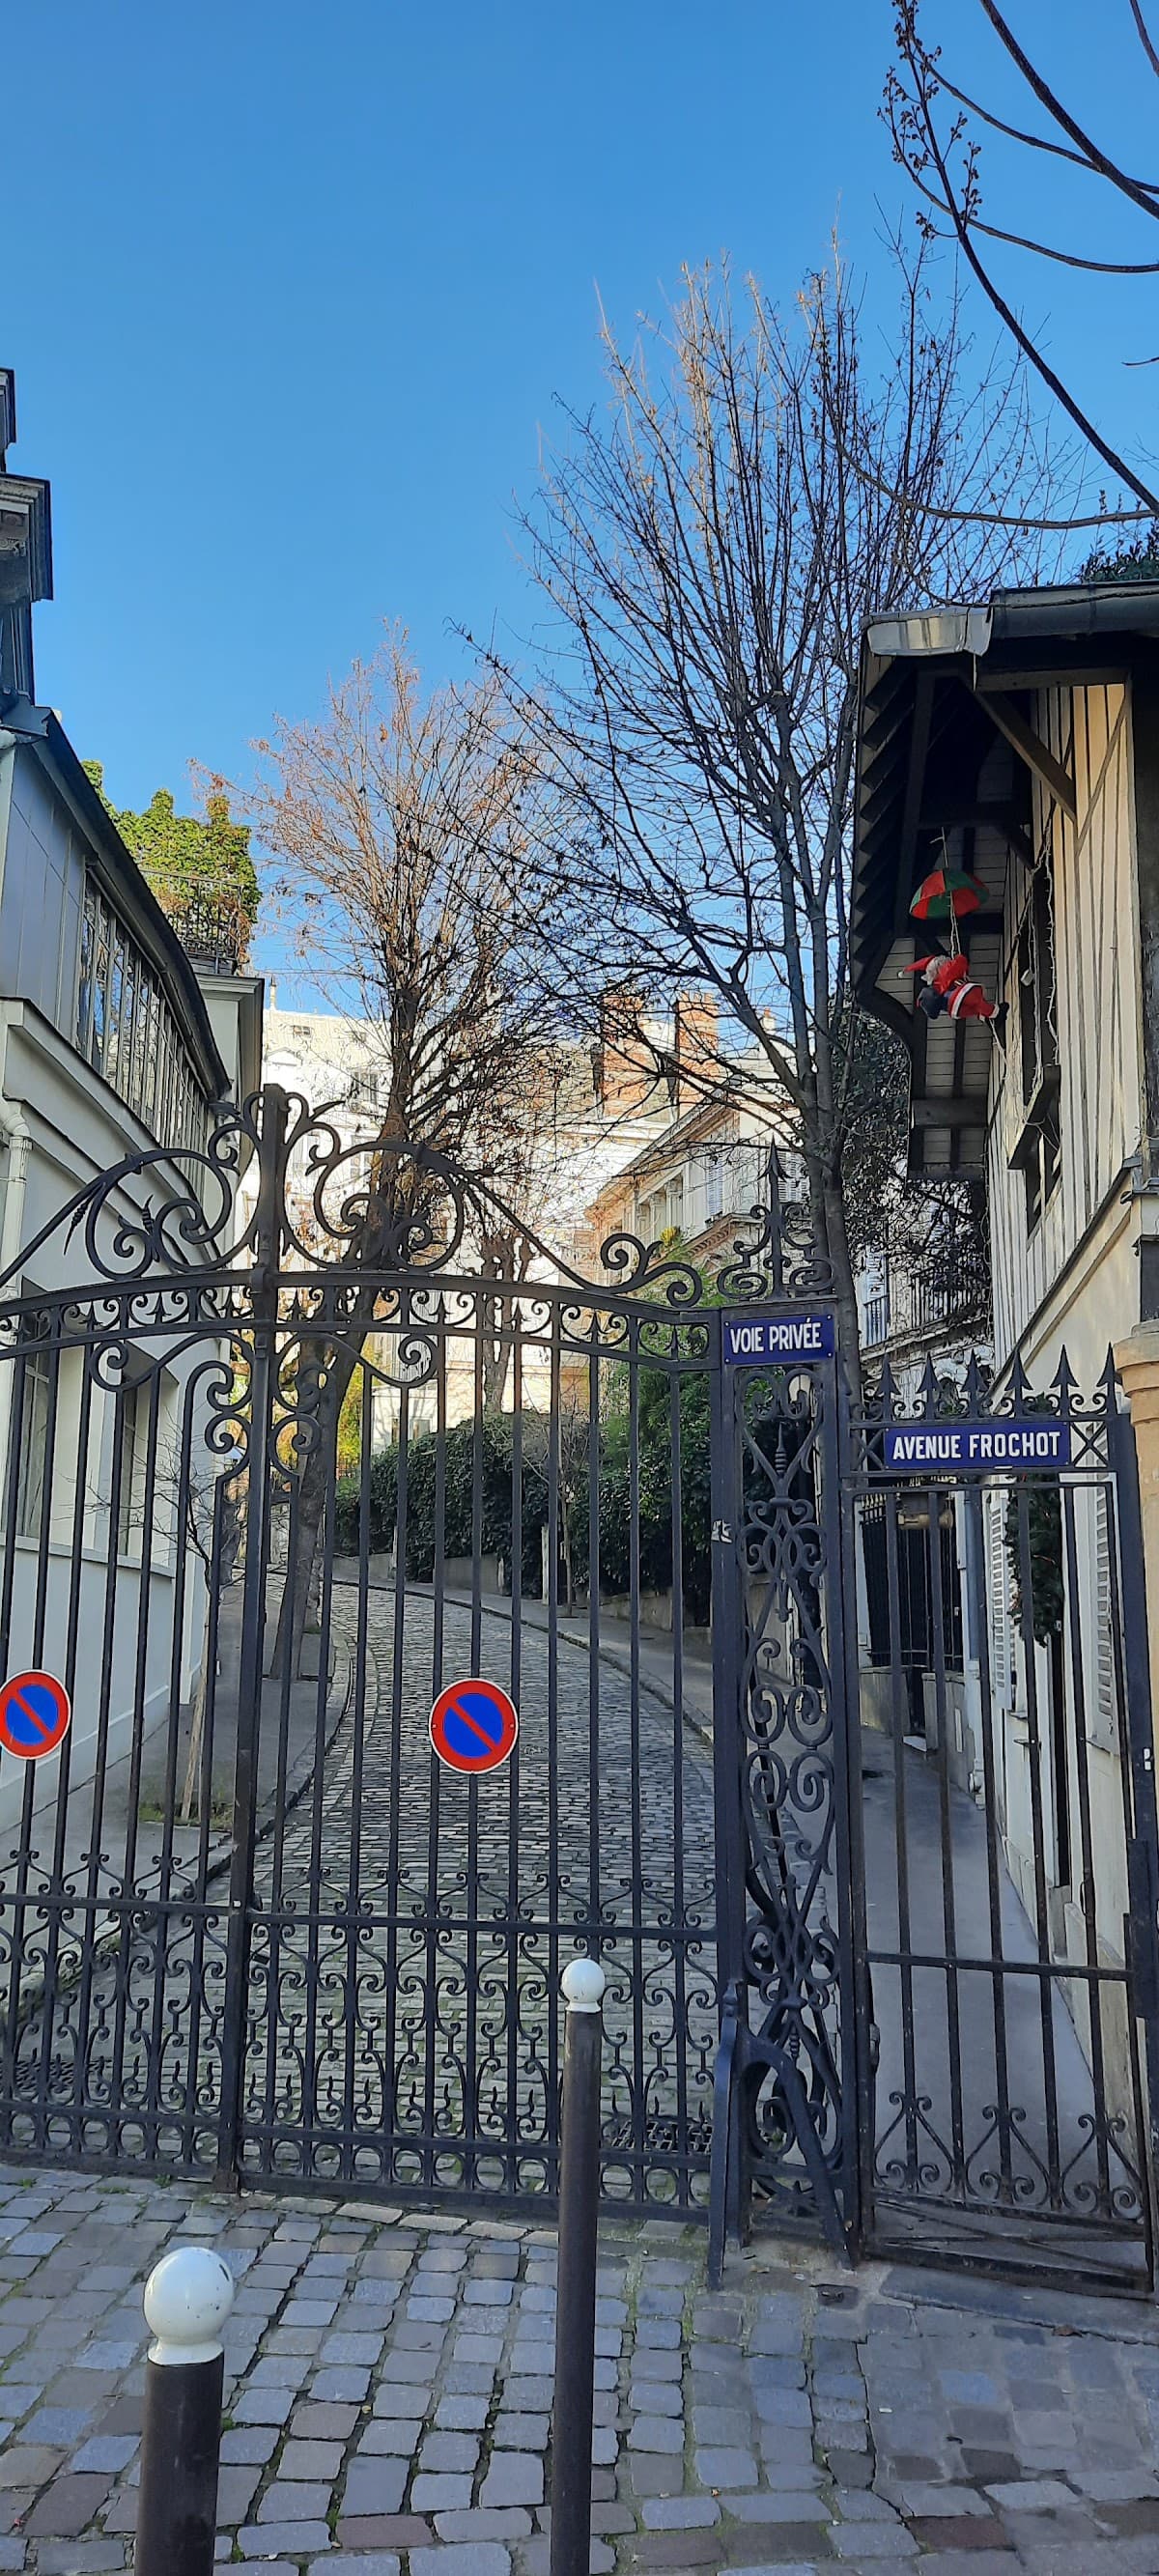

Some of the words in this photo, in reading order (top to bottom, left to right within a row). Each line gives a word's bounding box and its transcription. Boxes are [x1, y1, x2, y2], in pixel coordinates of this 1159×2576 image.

[730, 1326, 764, 1353] VOIE
[769, 1316, 822, 1350] PRIVÉE
[892, 1434, 962, 1459] AVENUE
[969, 1431, 1061, 1458] FROCHOT
